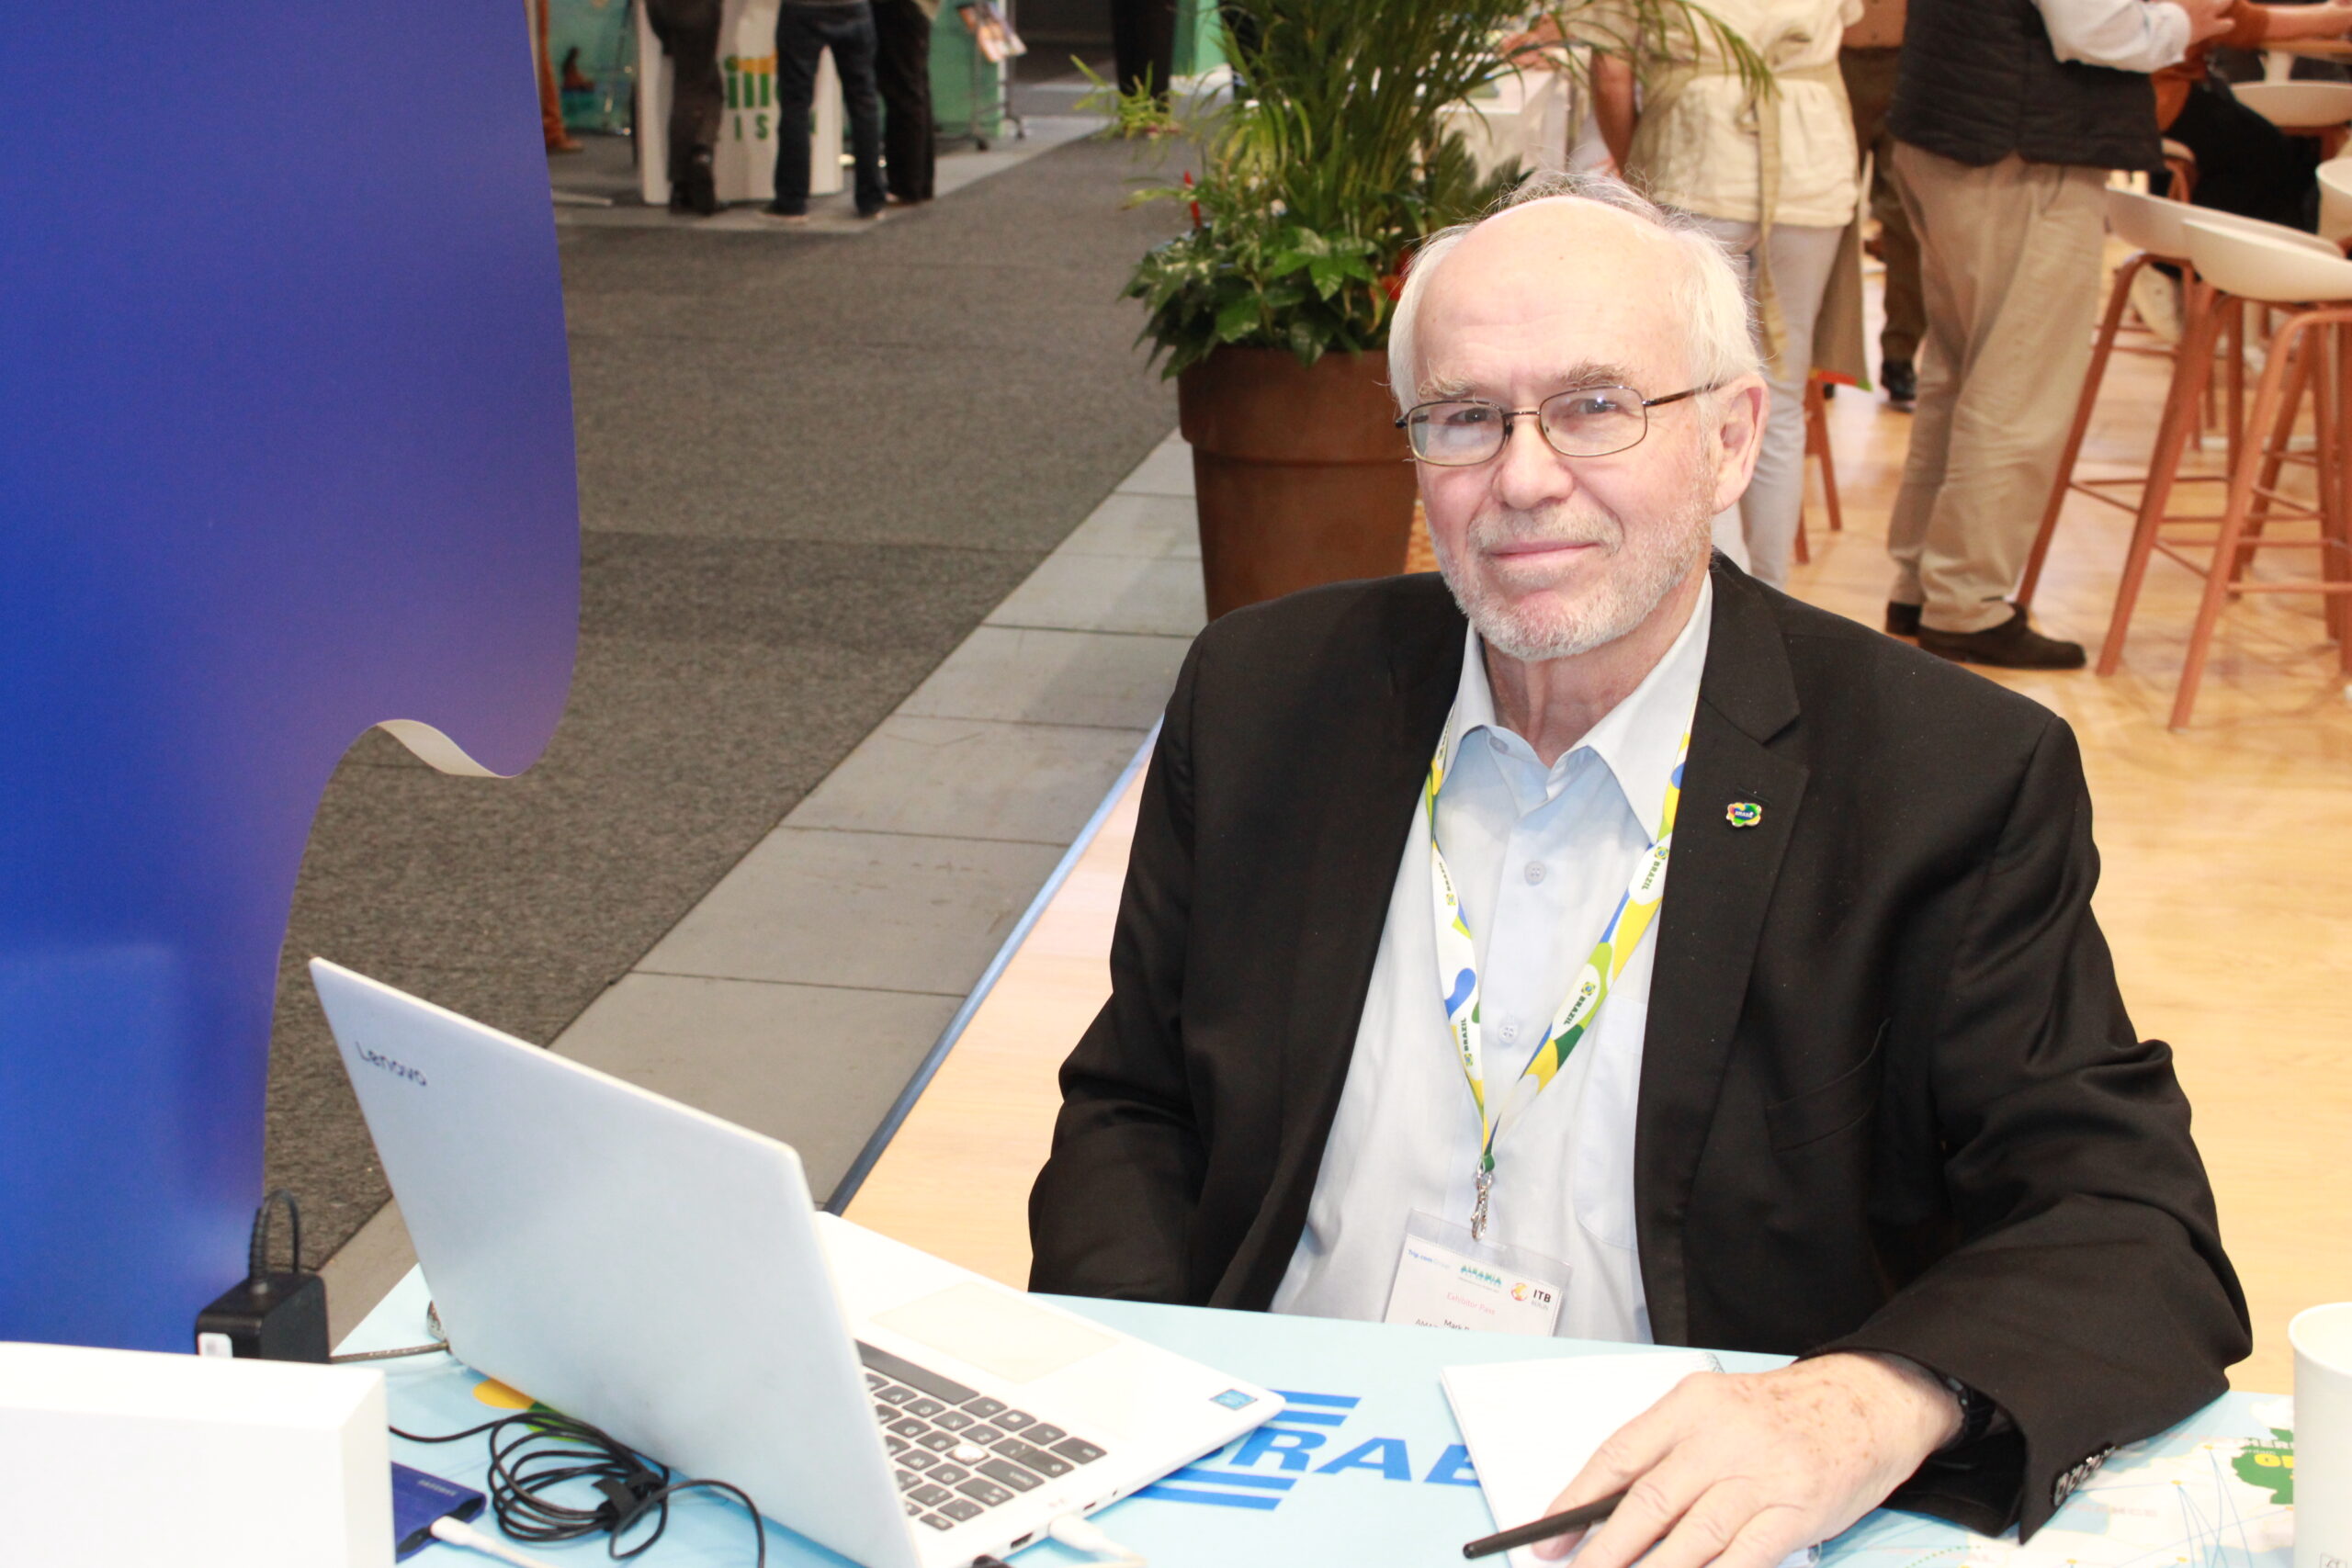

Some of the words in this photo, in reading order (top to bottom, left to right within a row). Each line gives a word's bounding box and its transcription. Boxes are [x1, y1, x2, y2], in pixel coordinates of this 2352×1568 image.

[1641, 861, 1661, 890] BRAZIL
[1563, 996, 1587, 1025] BRAZIL
[1460, 1017, 1470, 1052] BRAZIL
[355, 1041, 428, 1087] Lenovo
[1446, 1292, 1478, 1308] Exhibitor
[1532, 1289, 1552, 1303] ITB
